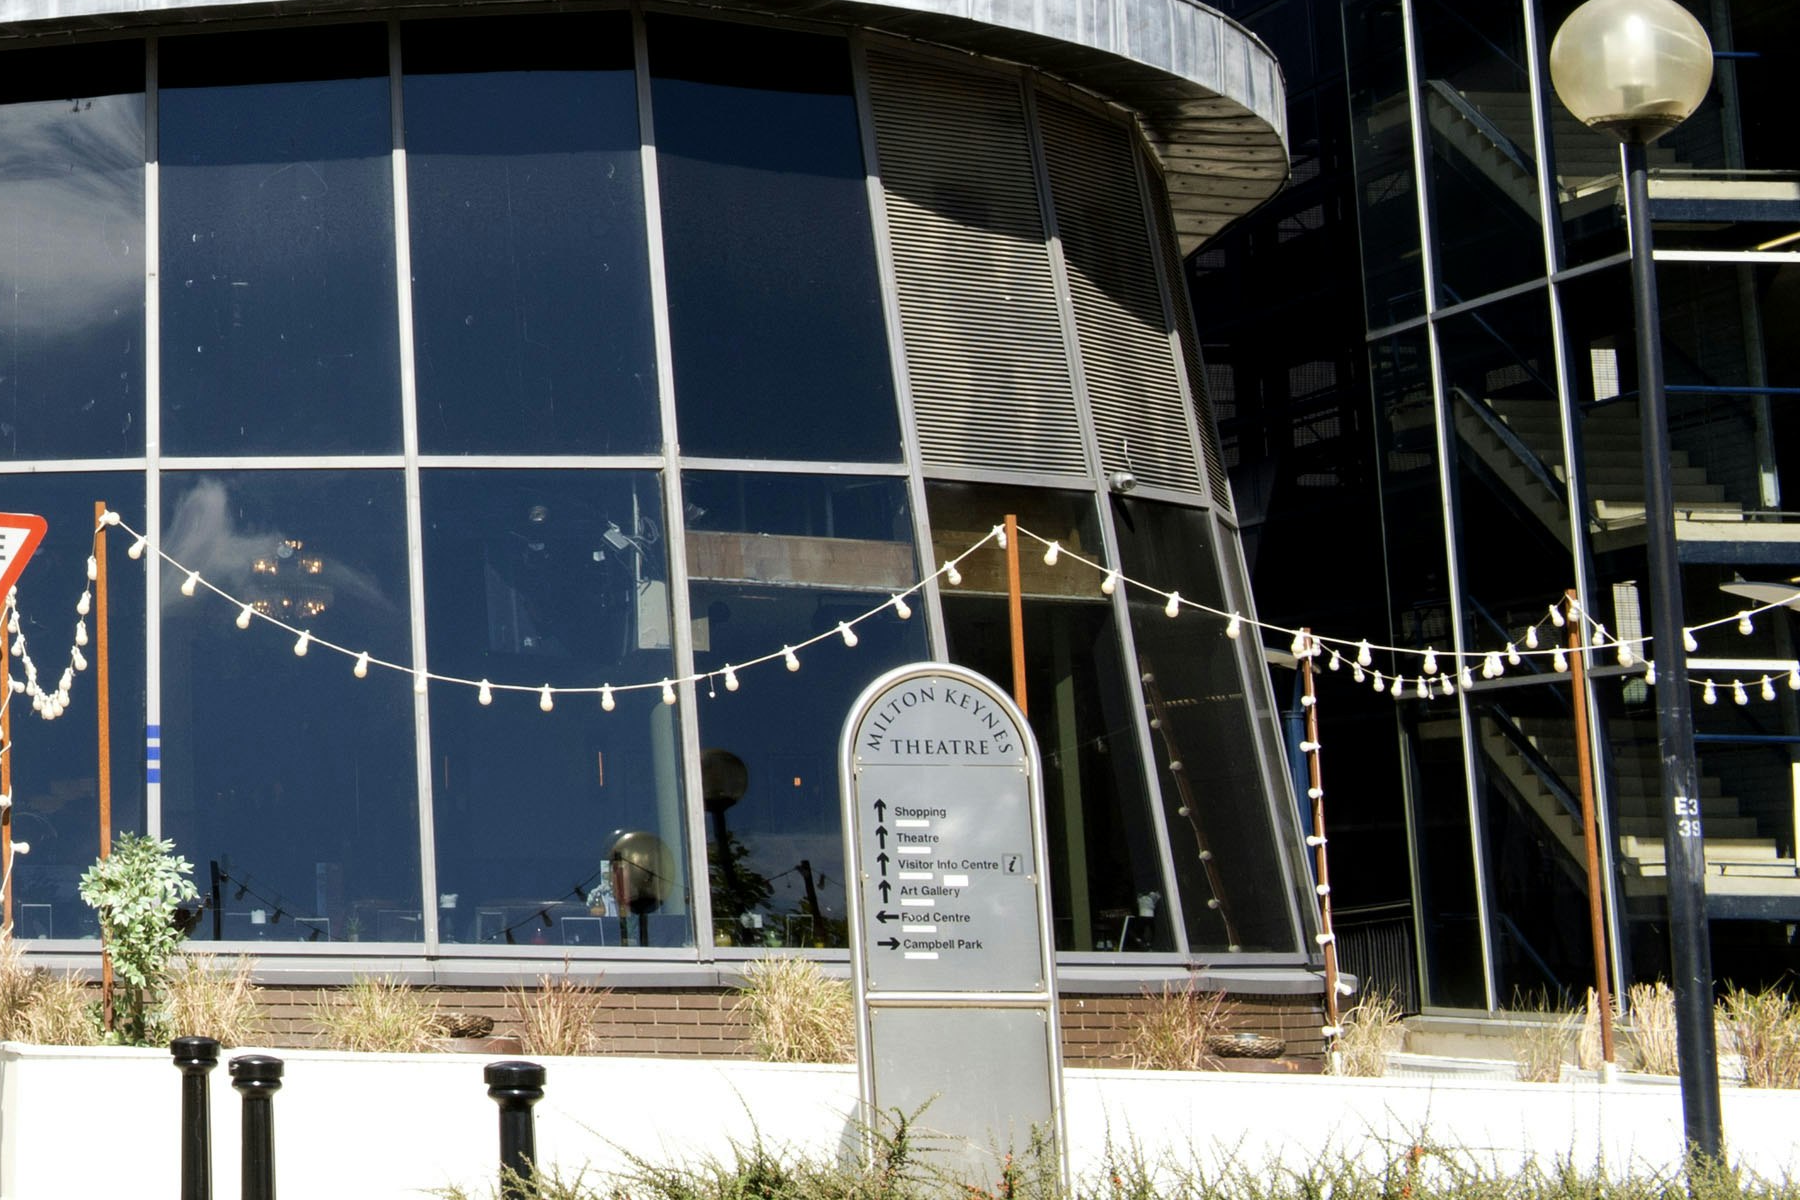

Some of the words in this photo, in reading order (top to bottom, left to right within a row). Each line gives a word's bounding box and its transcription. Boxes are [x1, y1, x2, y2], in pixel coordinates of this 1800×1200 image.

[867, 687, 935, 751] MILTON
[945, 688, 1014, 754] KEYNES
[890, 739, 989, 755] THEATRE
[1674, 796, 1699, 816] E3
[894, 806, 947, 819] Shopping
[1679, 820, 1701, 837] 39
[896, 833, 940, 843] Theatre
[898, 859, 934, 869] Visitor
[938, 860, 958, 870] Info
[961, 860, 999, 870] Centre
[900, 886, 918, 896] Art
[921, 886, 960, 898] Gallery
[901, 913, 930, 922] Food
[933, 913, 971, 922] Centre
[903, 939, 955, 951] Campbell
[958, 940, 983, 949] Park
